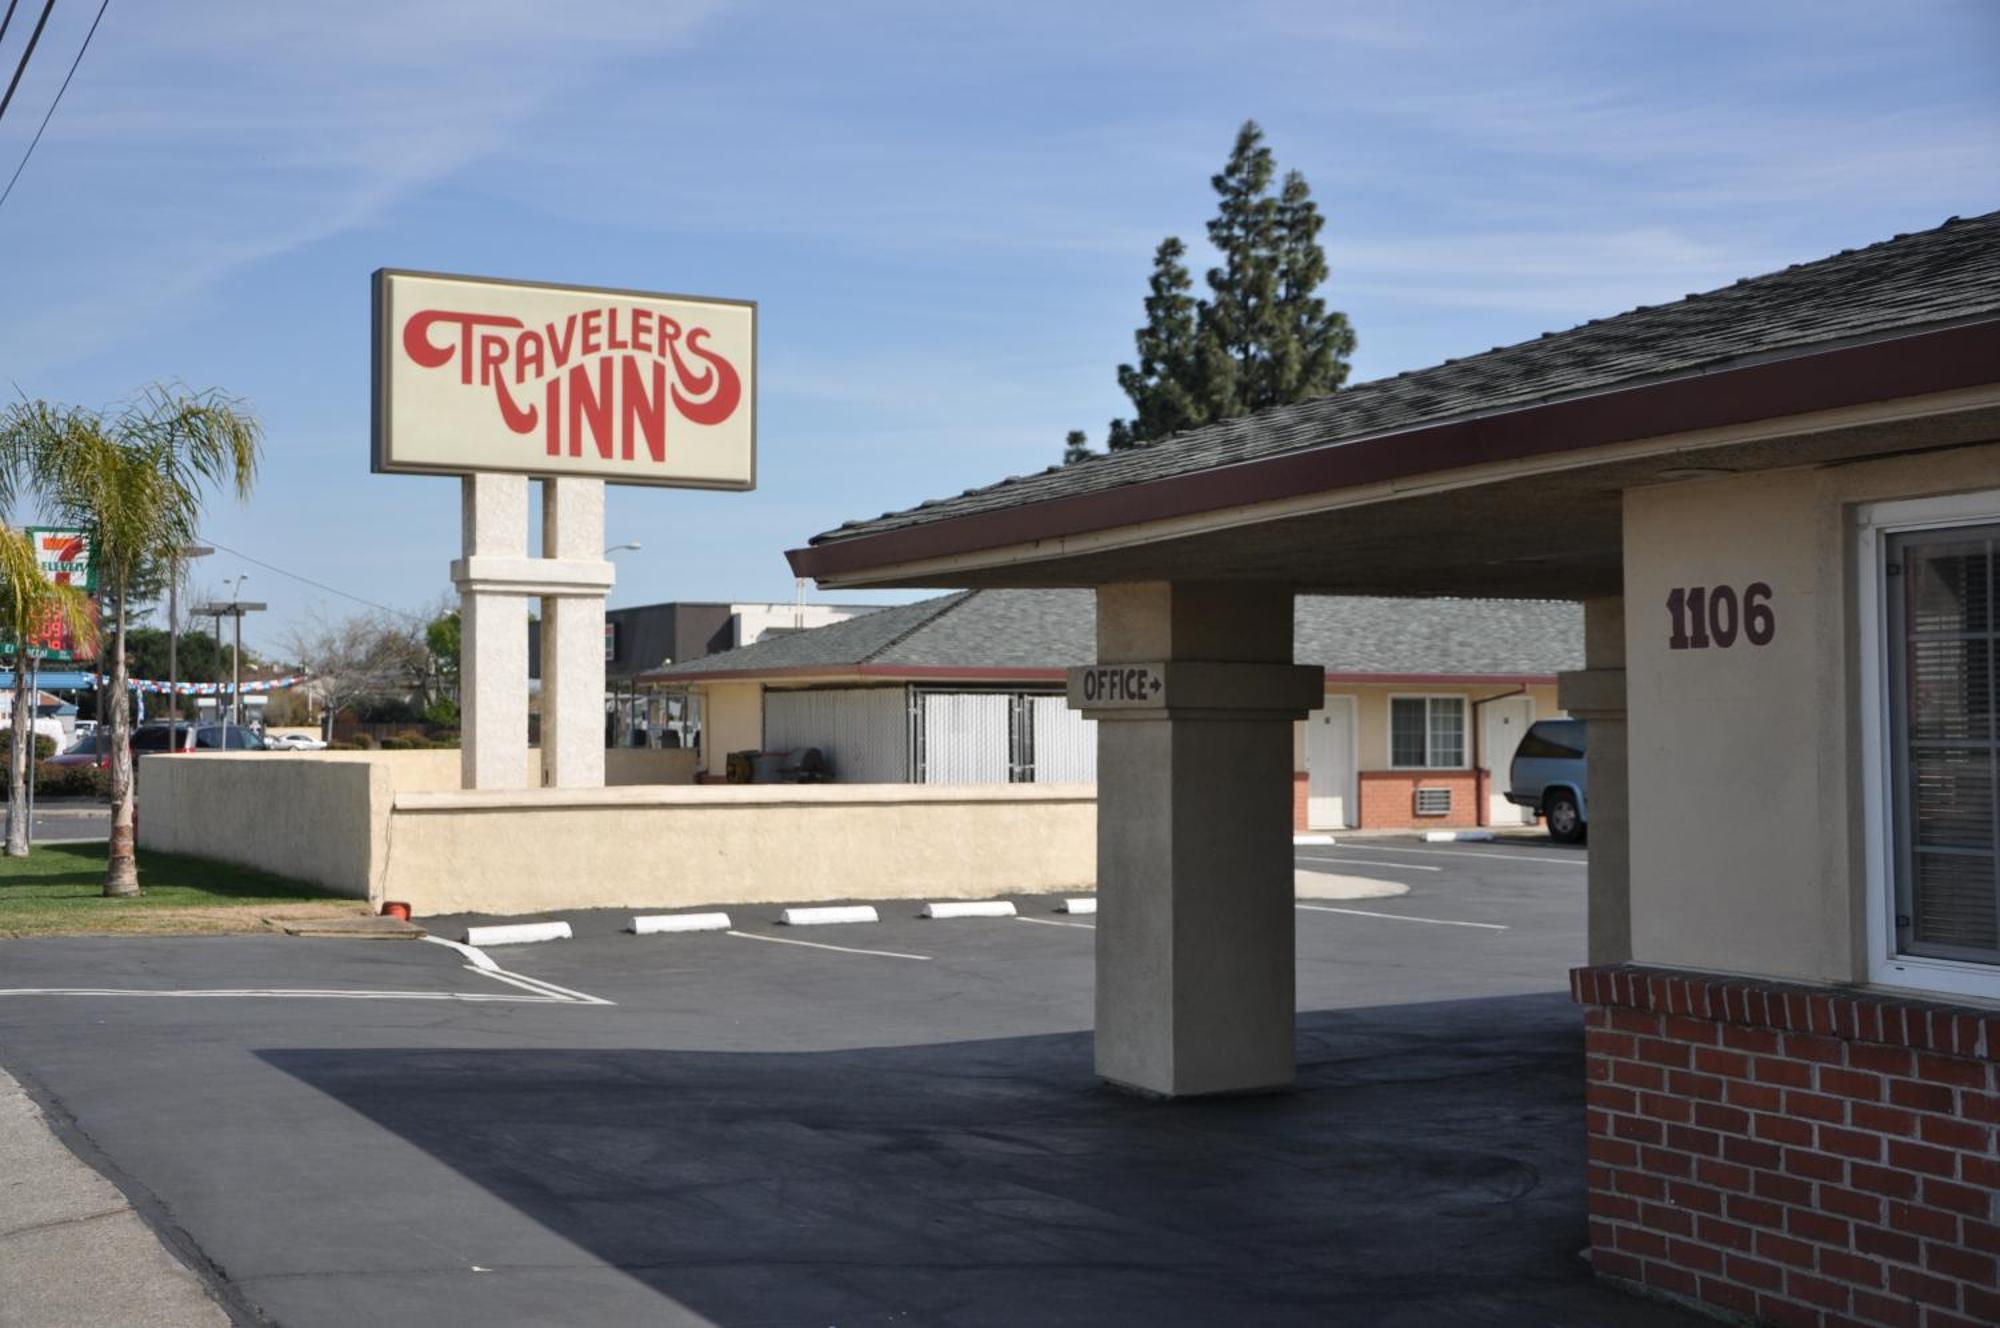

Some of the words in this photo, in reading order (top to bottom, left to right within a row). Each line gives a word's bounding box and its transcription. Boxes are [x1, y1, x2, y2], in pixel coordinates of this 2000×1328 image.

[403, 307, 742, 435] TRAVELERS
[546, 355, 666, 463] INN
[43, 538, 83, 586] 7
[1666, 582, 1775, 649] 1106
[1083, 669, 1148, 700] OFFICE
